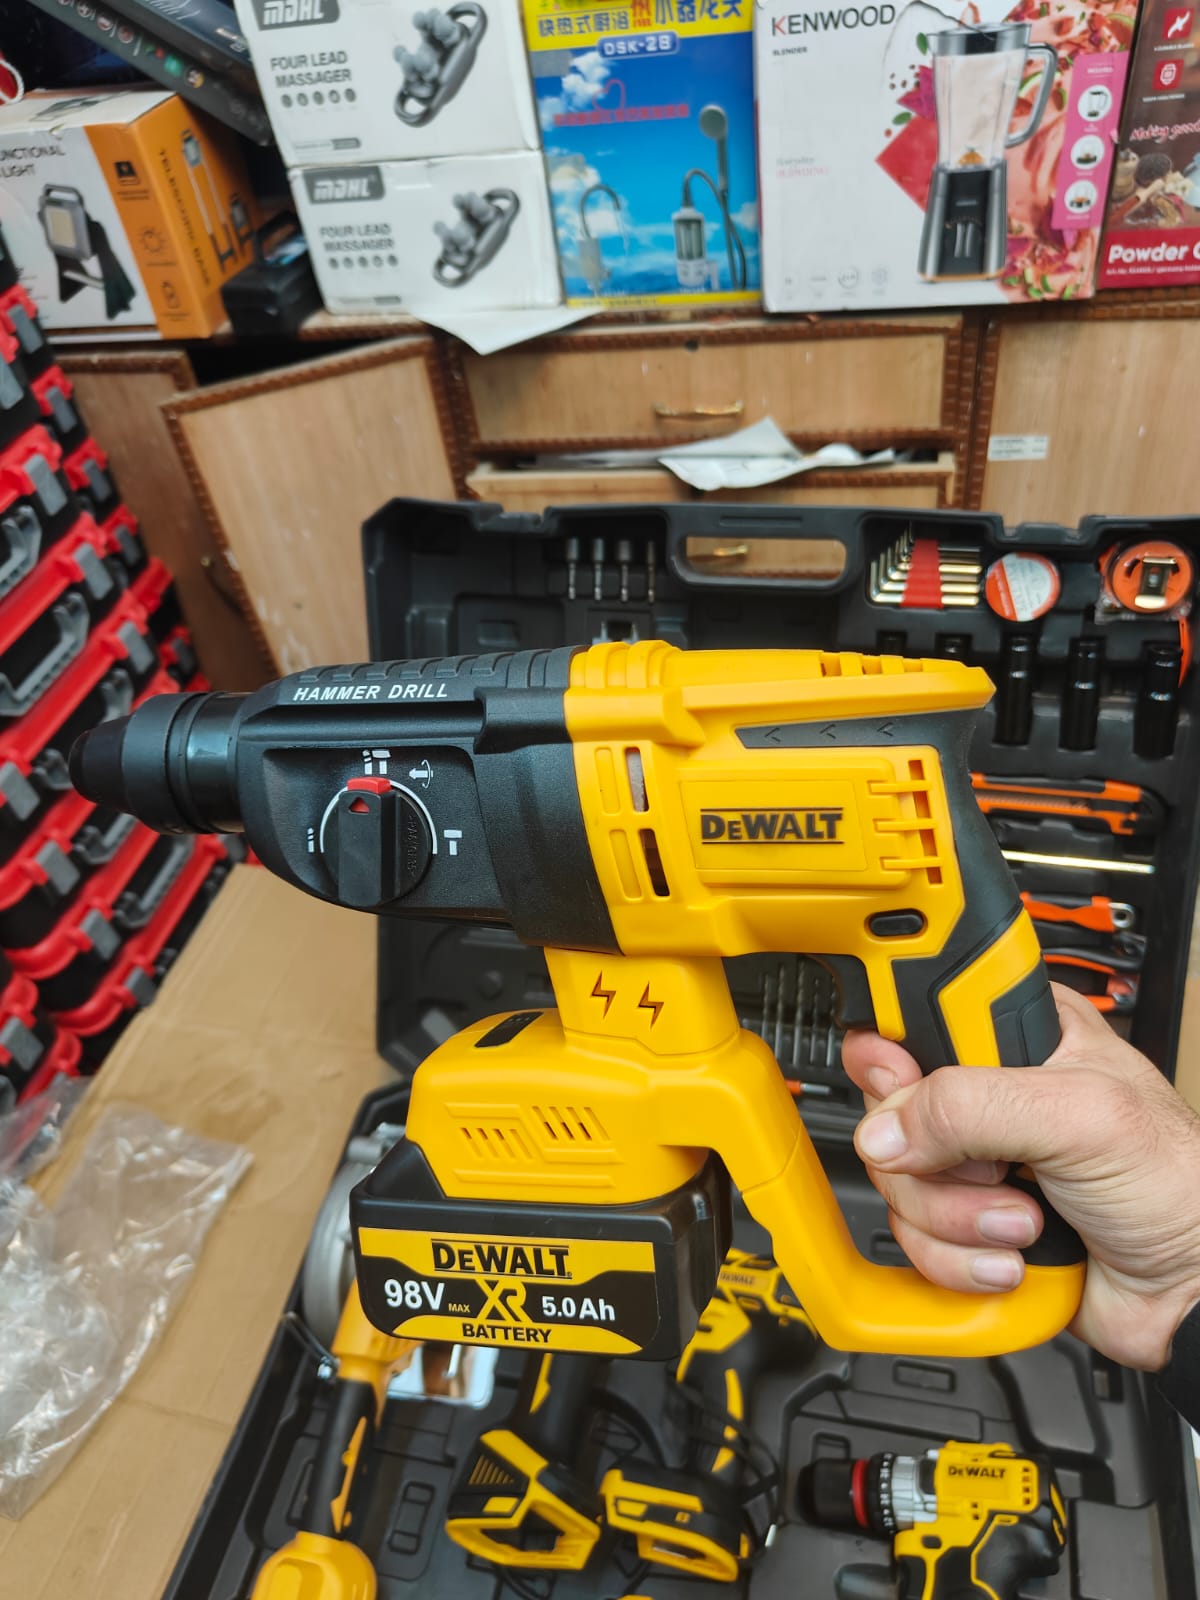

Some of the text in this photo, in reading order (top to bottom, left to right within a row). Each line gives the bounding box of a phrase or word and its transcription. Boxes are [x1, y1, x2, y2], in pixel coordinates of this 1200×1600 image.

[772, 5, 895, 36] KENWOOD
[270, 50, 348, 71] FOUR LEAD
[275, 68, 352, 88] MASSAGER
[319, 223, 392, 237] FOUR LEAD
[1108, 242, 1189, 264] Powder
[293, 683, 448, 701] HAMMER DRILL
[384, 1279, 446, 1311] 98V
[448, 1303, 471, 1313] MAX
[462, 1322, 552, 1343] BATTERY
